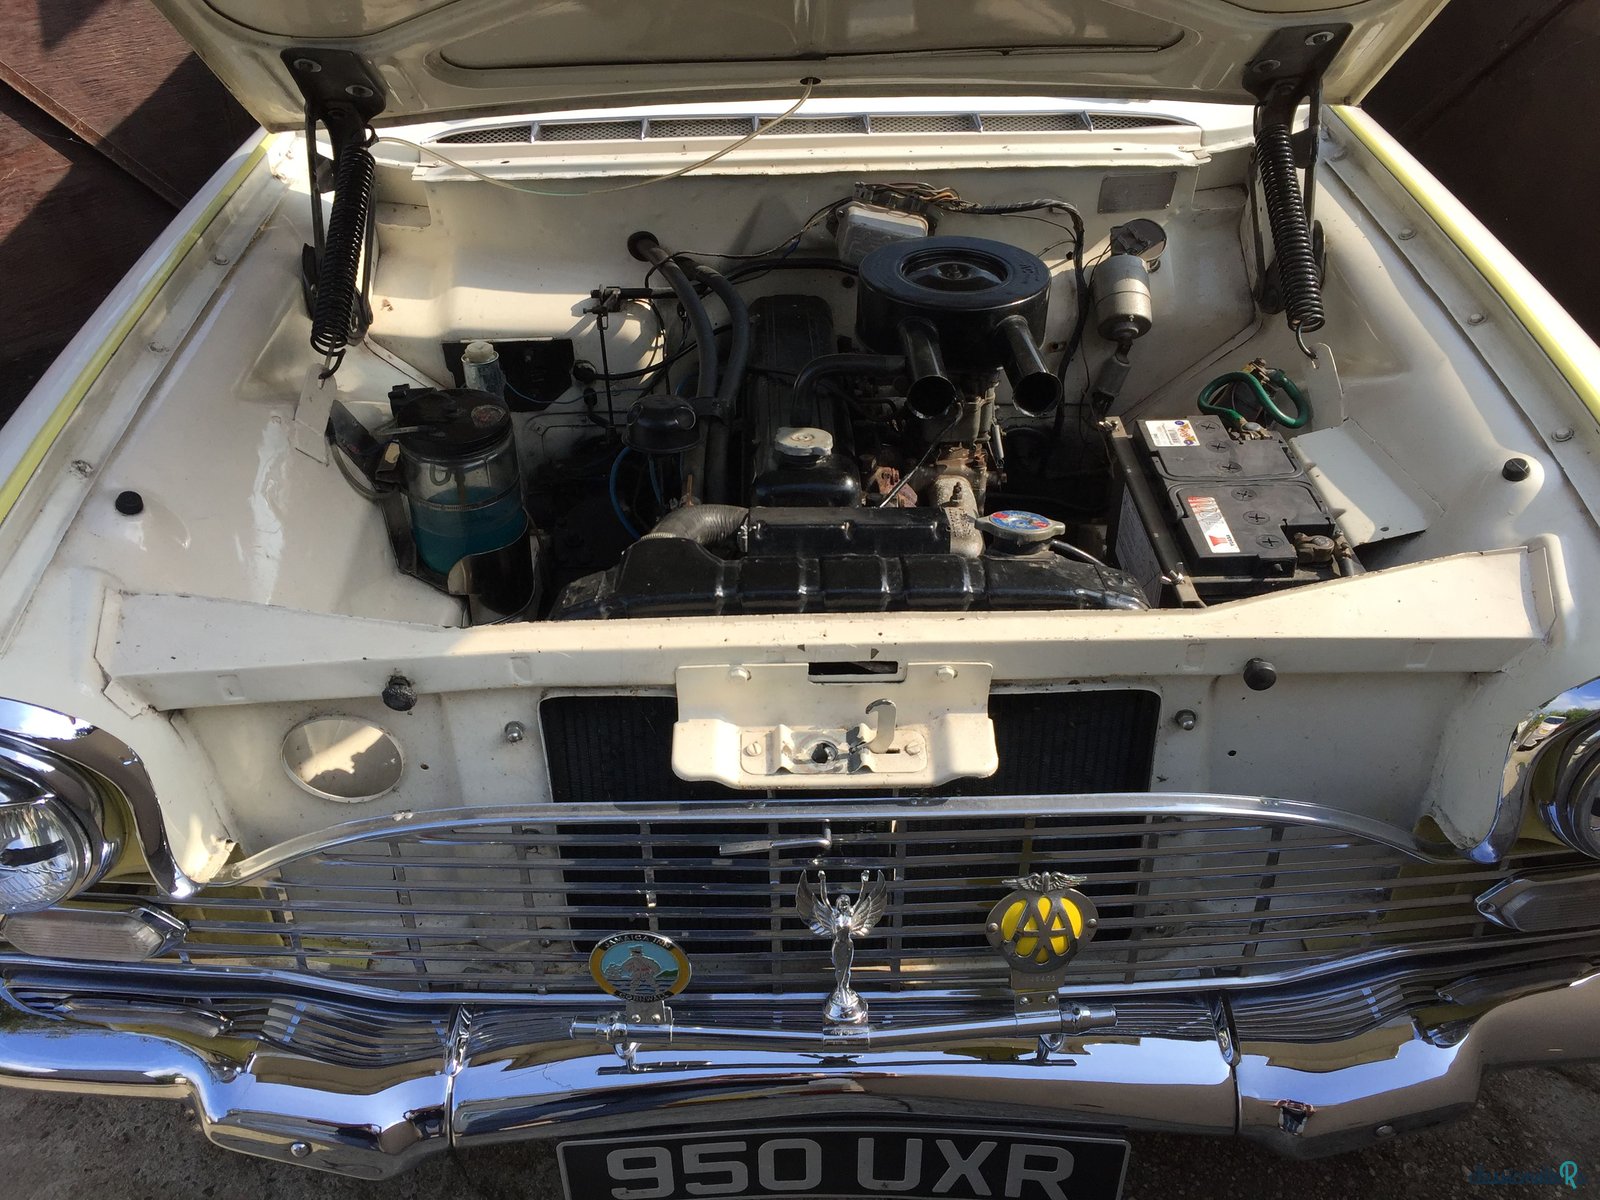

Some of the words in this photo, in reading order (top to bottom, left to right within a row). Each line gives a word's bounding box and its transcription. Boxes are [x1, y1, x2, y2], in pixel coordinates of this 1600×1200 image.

[605, 934, 649, 949] JAMAICA
[652, 937, 671, 949] INN
[1007, 894, 1080, 964] AA
[620, 993, 668, 1002] CORNWALL
[606, 1137, 822, 1199] 950
[856, 1138, 1075, 1200] UXR
